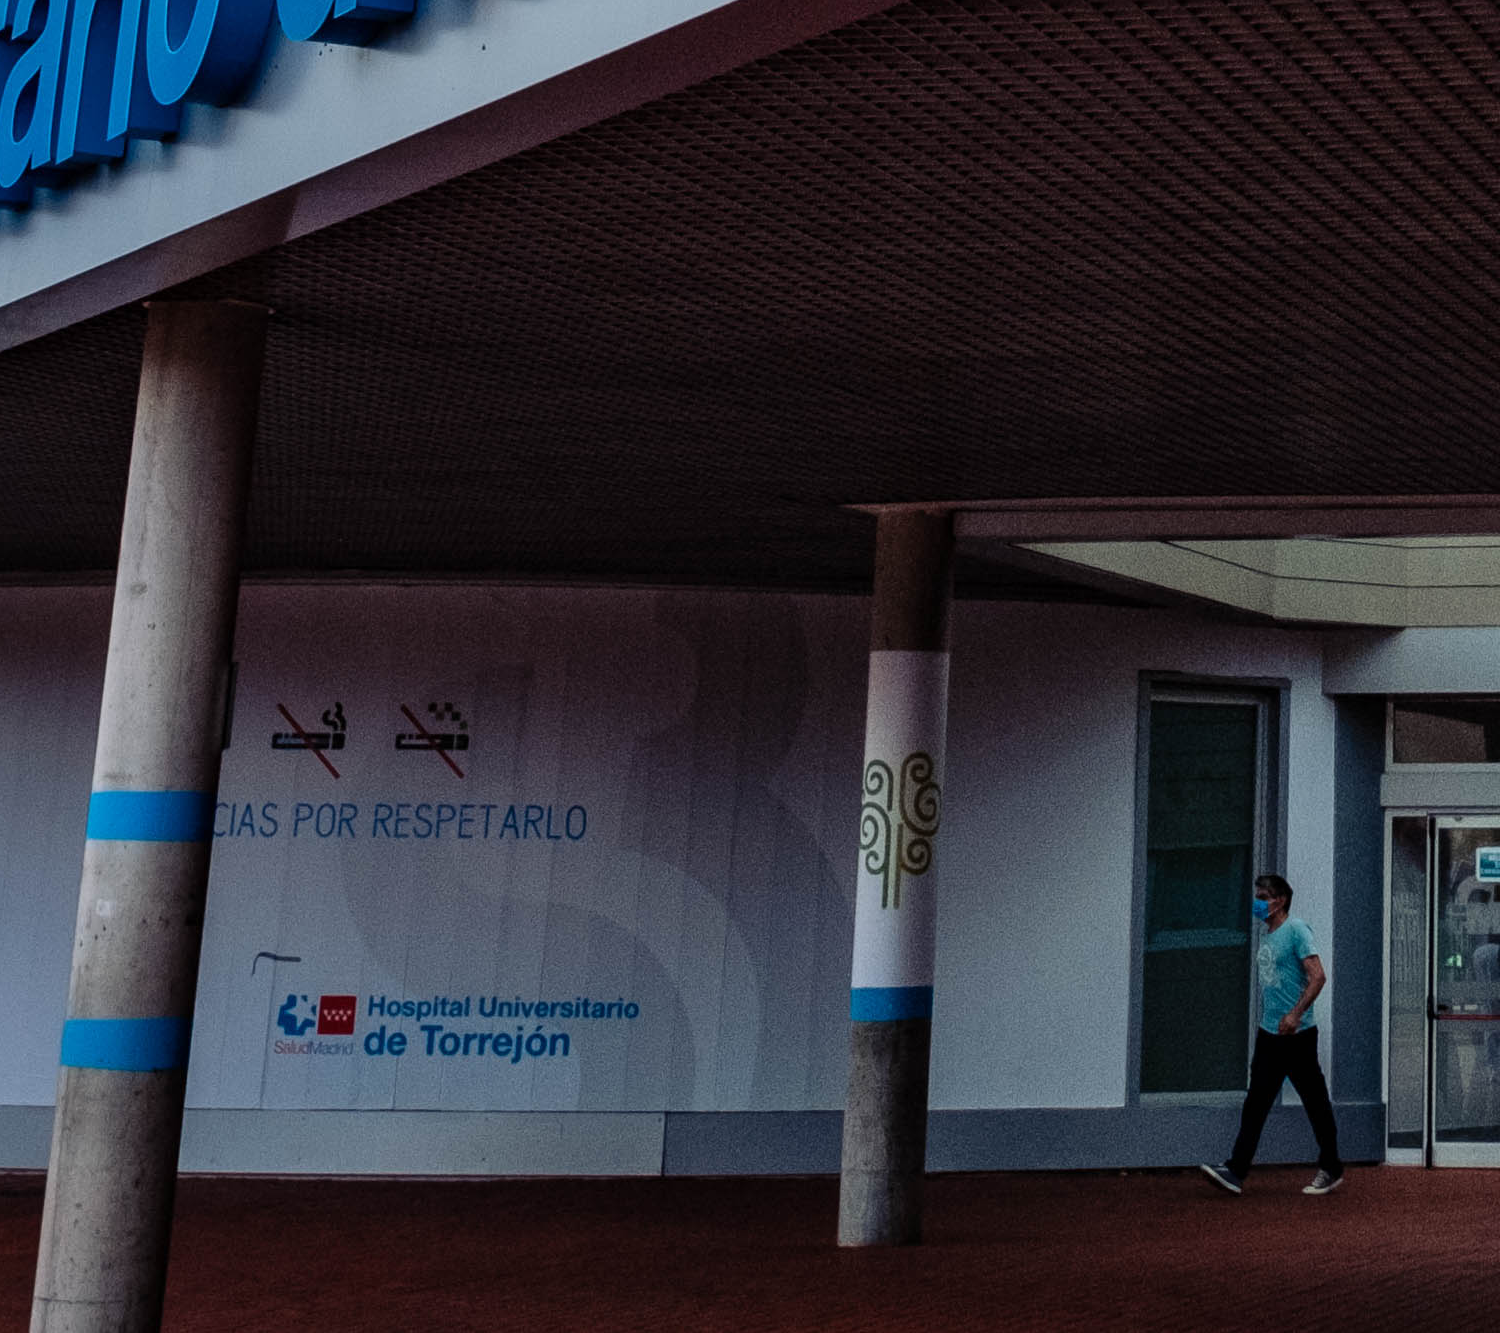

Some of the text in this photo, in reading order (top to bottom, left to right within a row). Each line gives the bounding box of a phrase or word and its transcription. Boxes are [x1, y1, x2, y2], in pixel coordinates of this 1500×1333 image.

[293, 802, 359, 838] POR
[372, 803, 588, 841] RESPETARLO
[367, 995, 640, 1021] Hospital Universitario
[363, 1025, 571, 1064] de Torrejón
